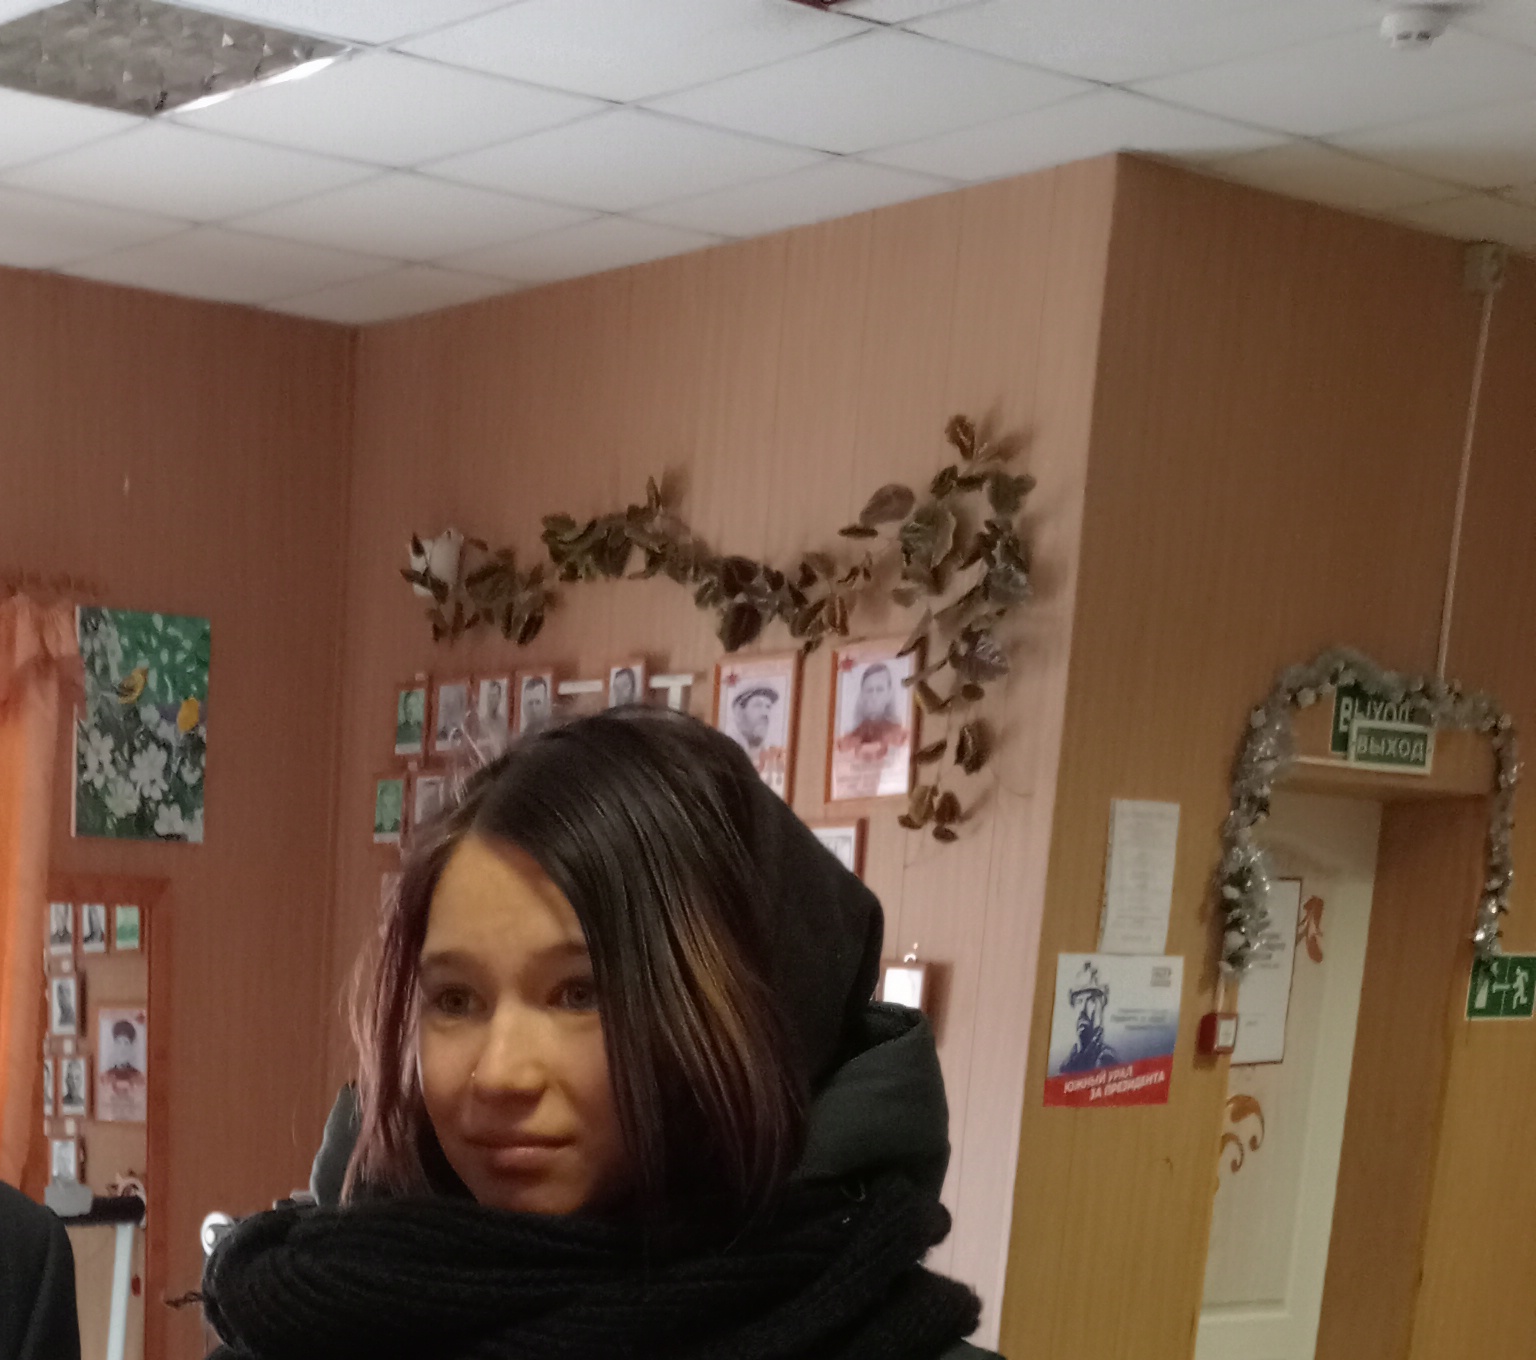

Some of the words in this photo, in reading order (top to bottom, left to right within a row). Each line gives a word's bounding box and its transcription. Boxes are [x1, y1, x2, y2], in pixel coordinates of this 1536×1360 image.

[1357, 734, 1424, 762] ВЫХОД
[1064, 1070, 1107, 1094] ЮЖНЫЙ
[1108, 1065, 1134, 1082] УРАЛ
[1104, 1071, 1165, 1096] ПРЕЗИДЕНТА
